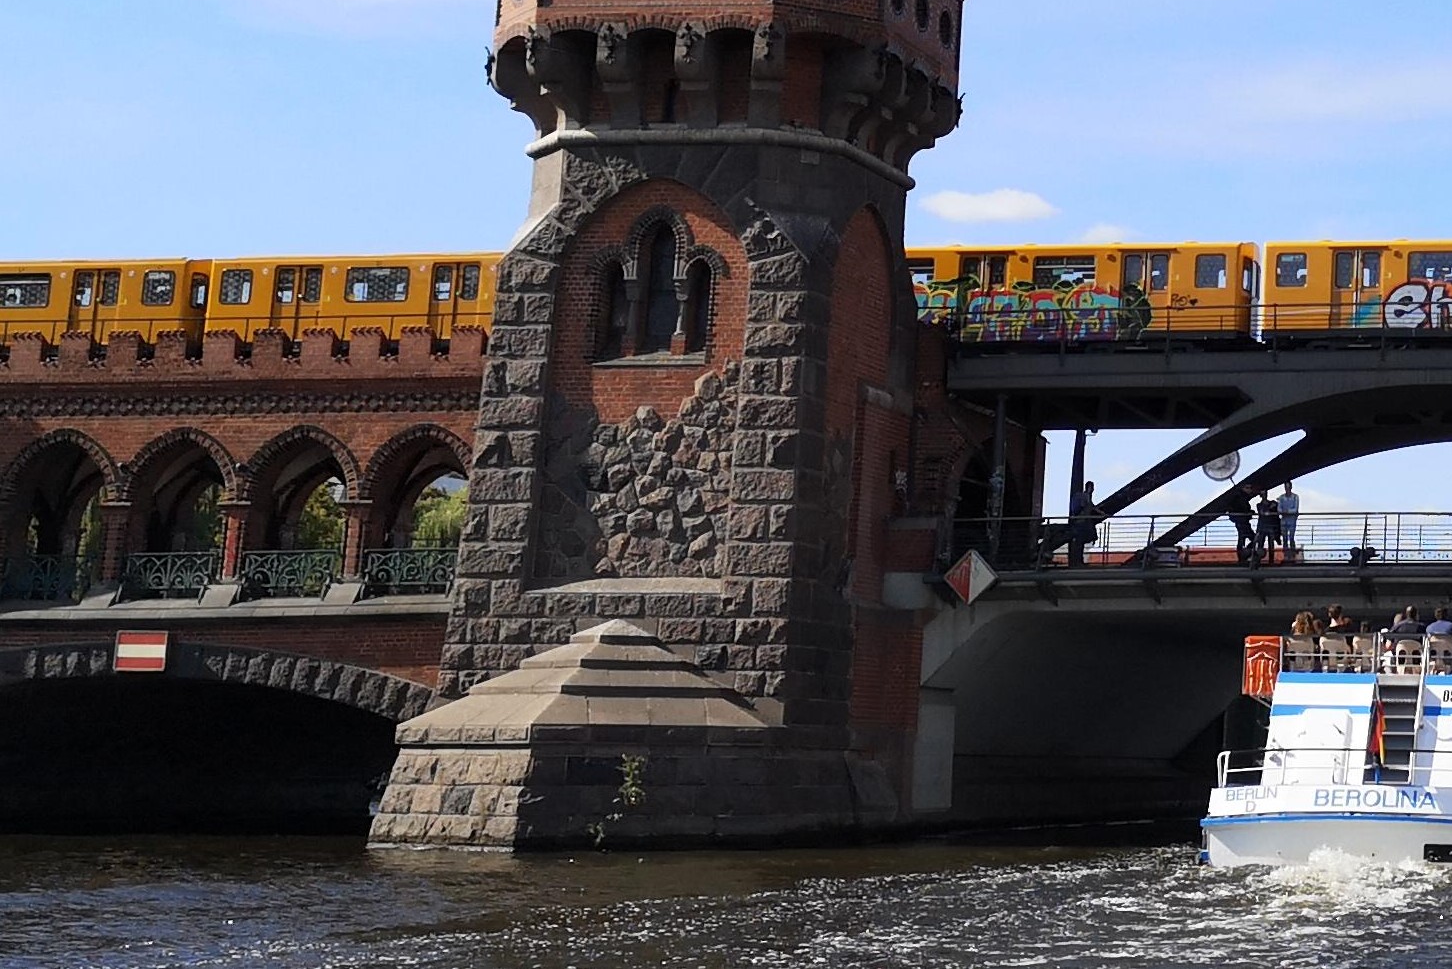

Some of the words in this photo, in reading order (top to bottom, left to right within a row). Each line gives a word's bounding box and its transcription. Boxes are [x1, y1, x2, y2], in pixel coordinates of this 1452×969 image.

[1225, 787, 1279, 803] BERLIN
[1313, 787, 1437, 809] BEROLINA
[1245, 800, 1256, 813] D
